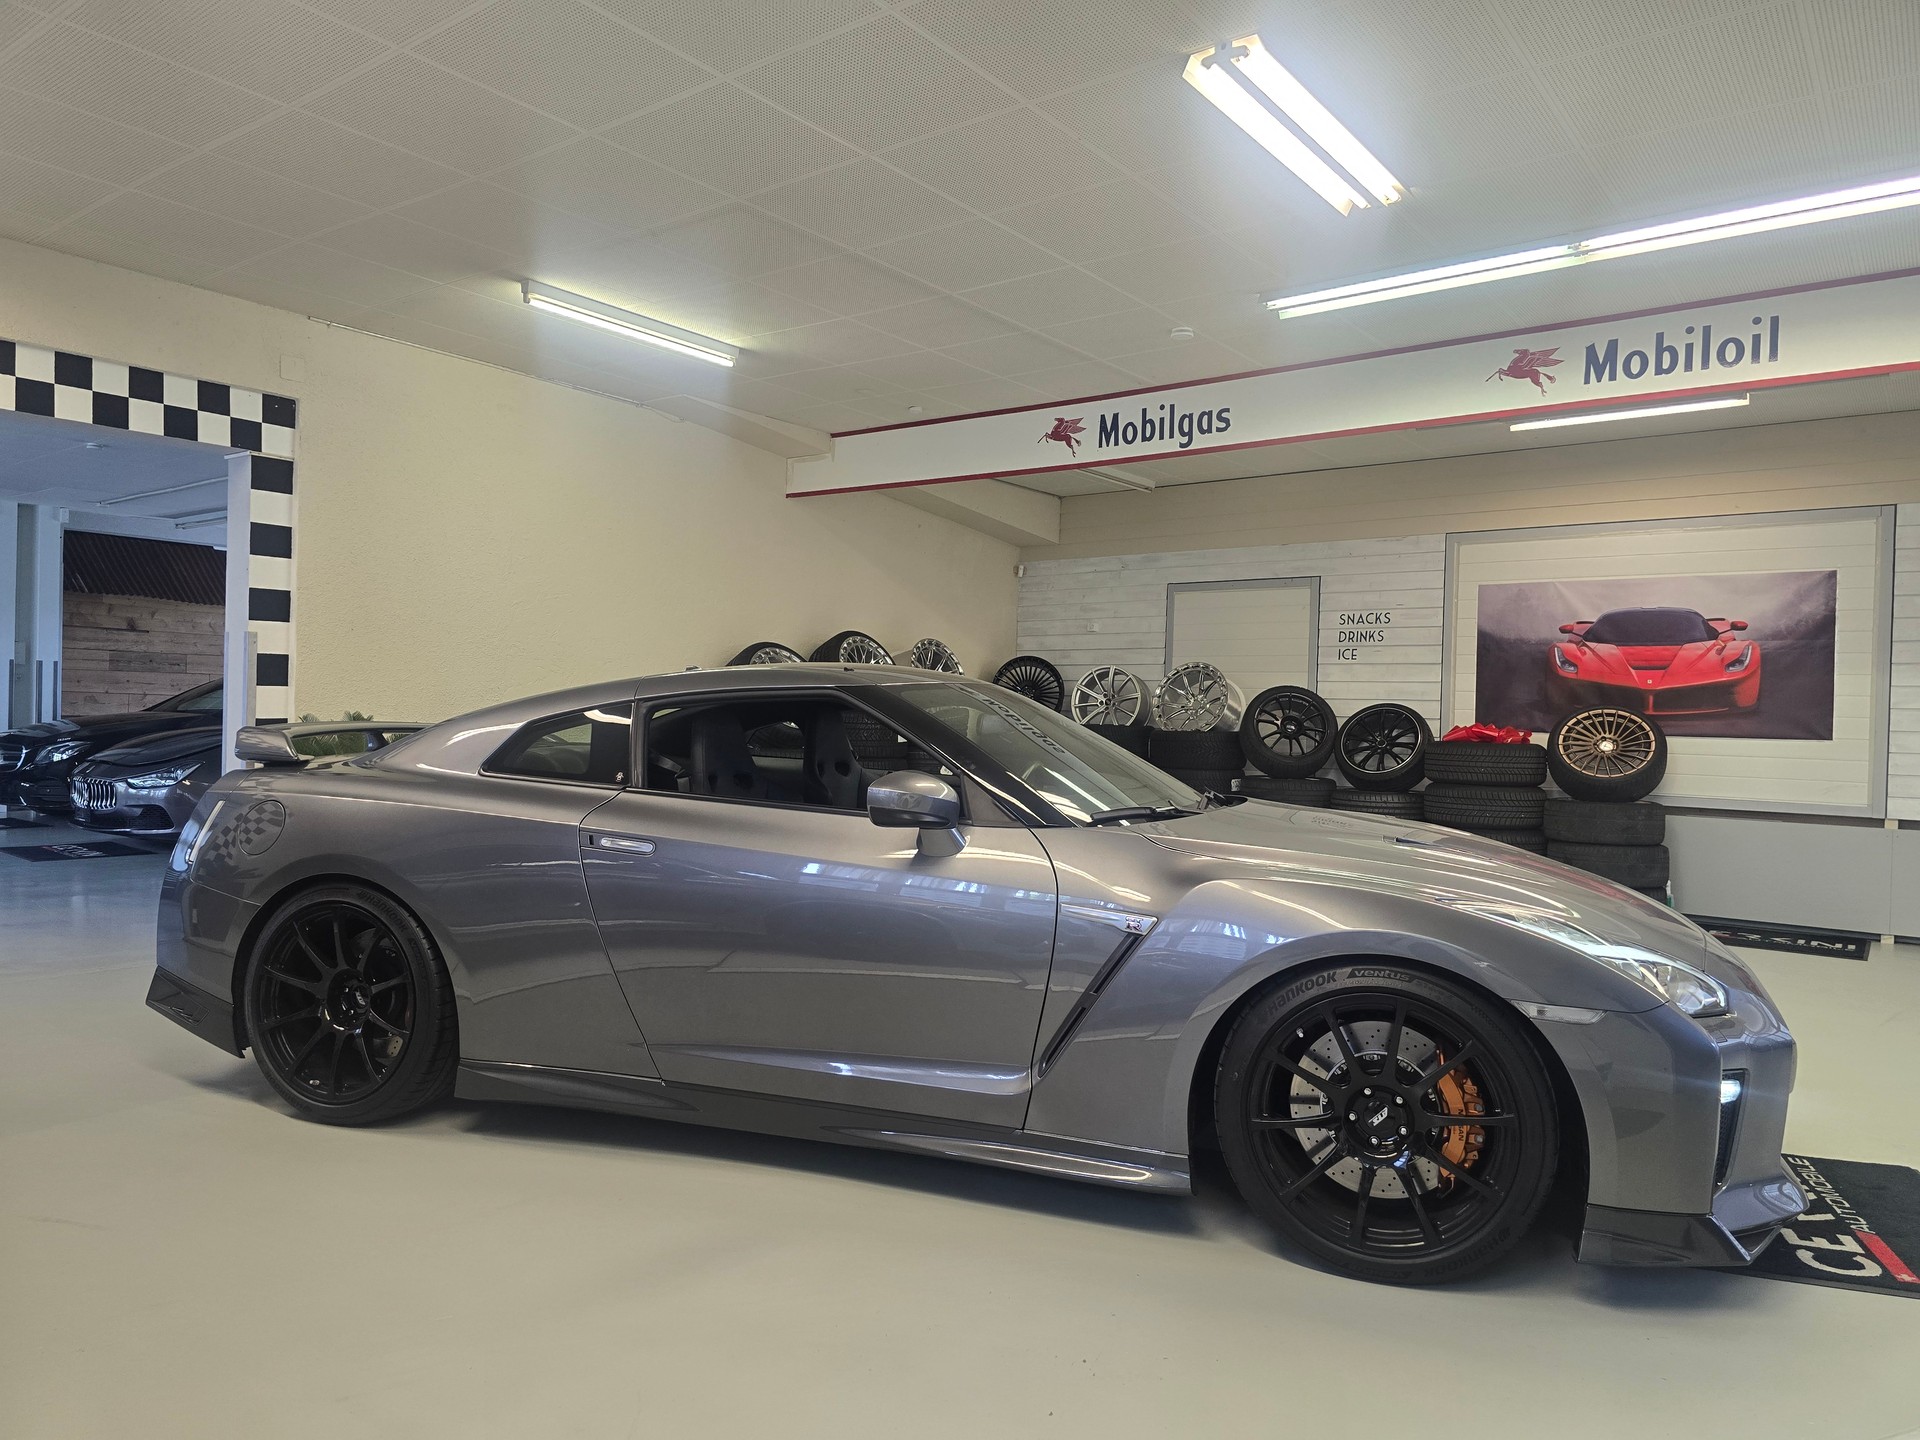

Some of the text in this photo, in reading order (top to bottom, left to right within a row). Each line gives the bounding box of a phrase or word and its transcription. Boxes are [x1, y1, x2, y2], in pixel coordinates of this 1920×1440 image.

[1584, 315, 1780, 385] Mobiloil
[1098, 404, 1232, 449] Mobilgas
[1339, 612, 1391, 625] SNACKS
[1338, 630, 1384, 643] DRINKS
[1337, 648, 1358, 660] ICE
[1787, 1156, 1876, 1234] AUTOMOBILE
